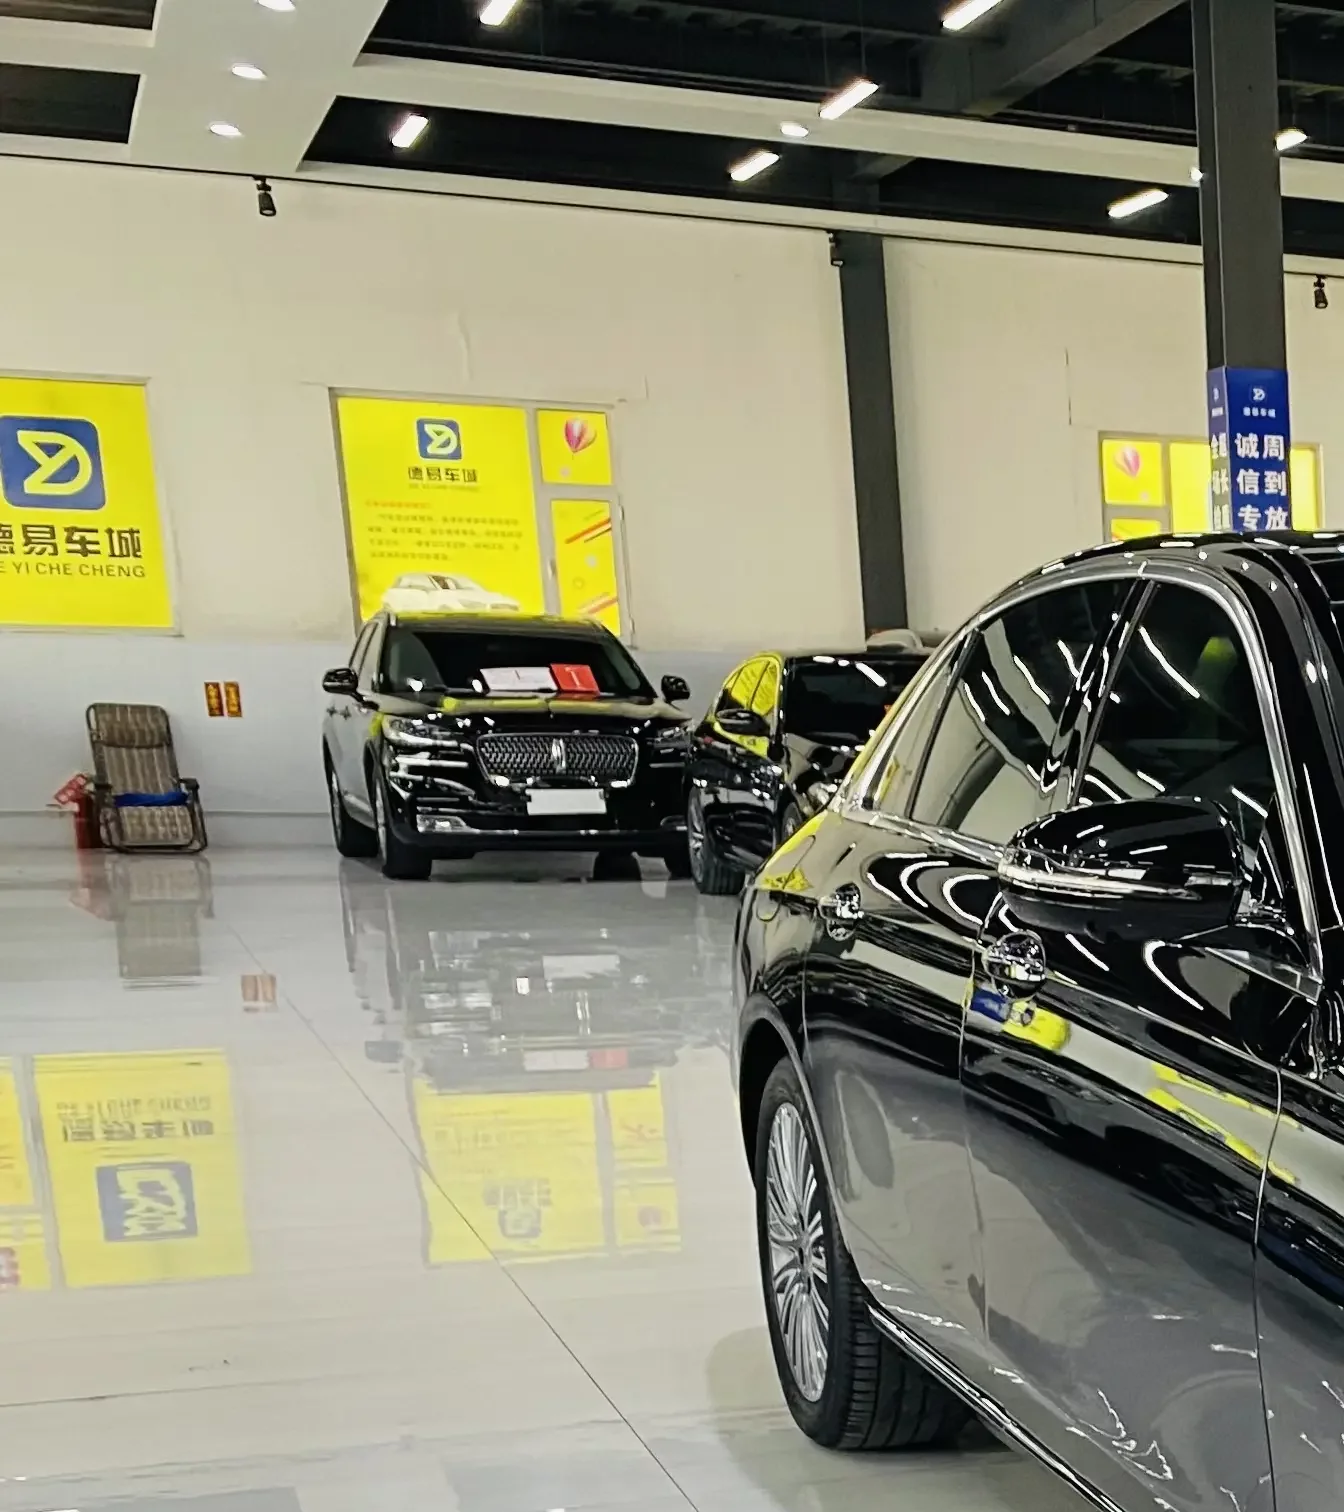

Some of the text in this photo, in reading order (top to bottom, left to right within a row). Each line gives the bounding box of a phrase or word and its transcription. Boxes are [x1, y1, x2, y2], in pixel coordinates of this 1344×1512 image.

[408, 466, 478, 482] 德易车城
[35, 562, 73, 576] CHE
[78, 564, 146, 578] CHENG
